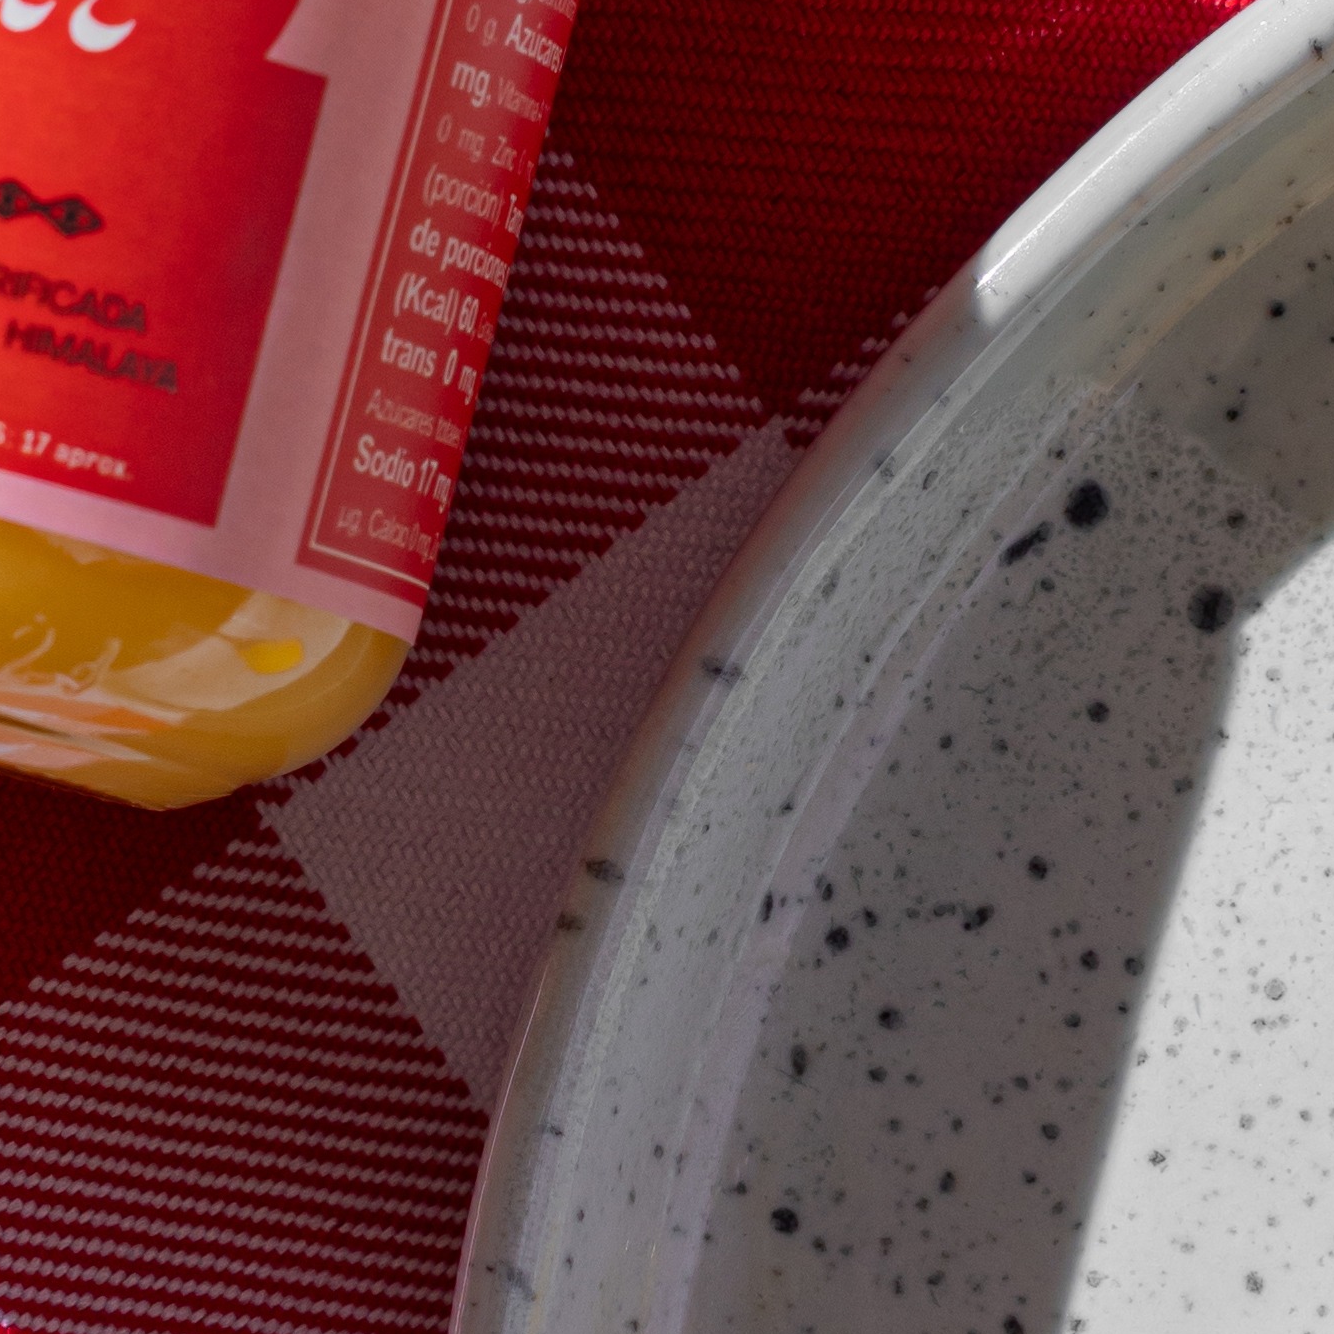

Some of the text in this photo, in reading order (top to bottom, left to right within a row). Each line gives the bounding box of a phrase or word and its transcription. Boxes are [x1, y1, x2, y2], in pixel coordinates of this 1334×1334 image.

[411, 219, 441, 257] de
[394, 271, 460, 336] (Kcal)
[3, 319, 178, 396] HIMALAYA
[382, 327, 439, 378] trans
[443, 349, 460, 386] 0
[21, 429, 52, 455] 17
[353, 433, 417, 488] Sodio
[421, 463, 438, 498] 17
